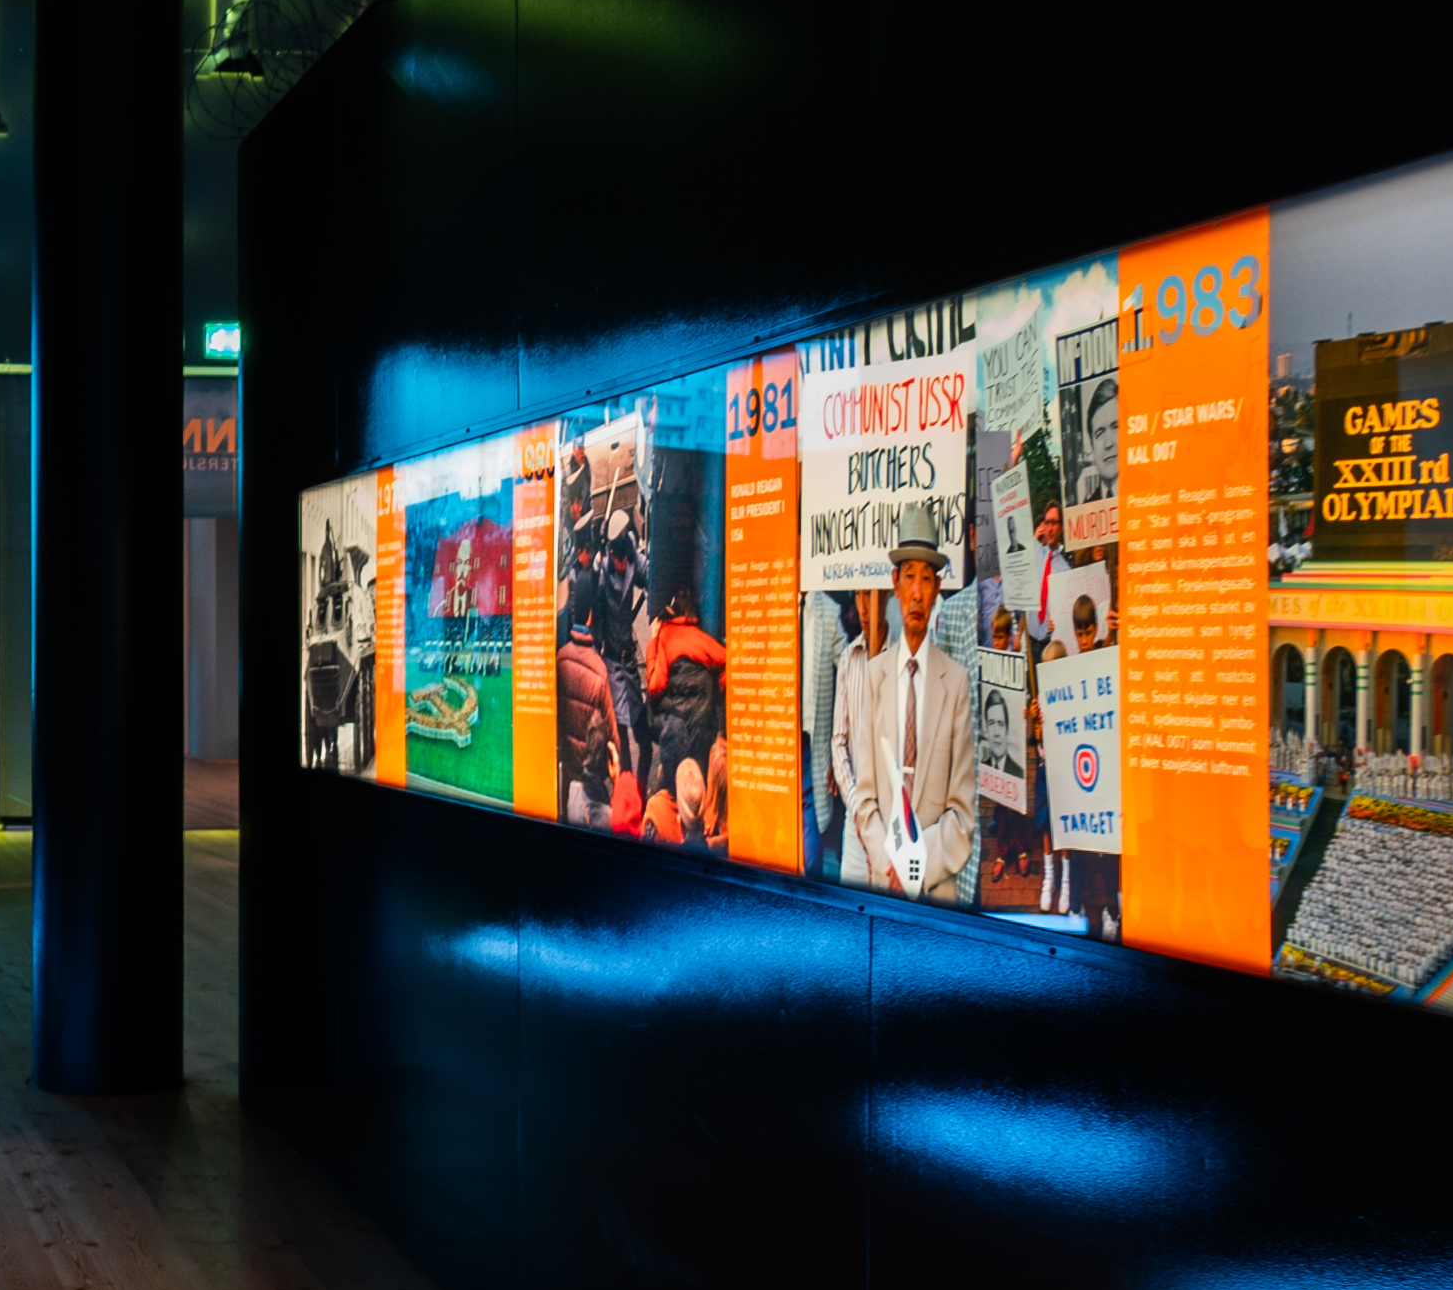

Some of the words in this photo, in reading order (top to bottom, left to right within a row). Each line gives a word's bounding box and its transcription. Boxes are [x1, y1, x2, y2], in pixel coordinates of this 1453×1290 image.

[1122, 254, 1261, 353] 1983
[983, 343, 1008, 380] YOU
[728, 378, 797, 441] 1981
[823, 377, 915, 440] COMMUNIST
[919, 372, 965, 432] USSR
[1125, 412, 1148, 435] SDI
[1161, 404, 1195, 430] STAR
[1344, 398, 1440, 435] GAMES
[515, 439, 555, 485] 1980
[1127, 446, 1150, 466] KAL
[1151, 439, 1177, 462] 007
[1369, 435, 1386, 455] OF
[1389, 434, 1413, 453] THE
[848, 442, 935, 495] BUTCHERS
[1333, 455, 1418, 488] XXIII
[1419, 453, 1450, 484] rd
[811, 501, 870, 558] INNOCENT
[1045, 684, 1074, 705] WILL
[1081, 680, 1089, 701] I
[1097, 676, 1113, 696] BE
[1055, 717, 1078, 735] THE
[1084, 711, 1115, 731] NEXT
[1060, 811, 1114, 835] TARGET
